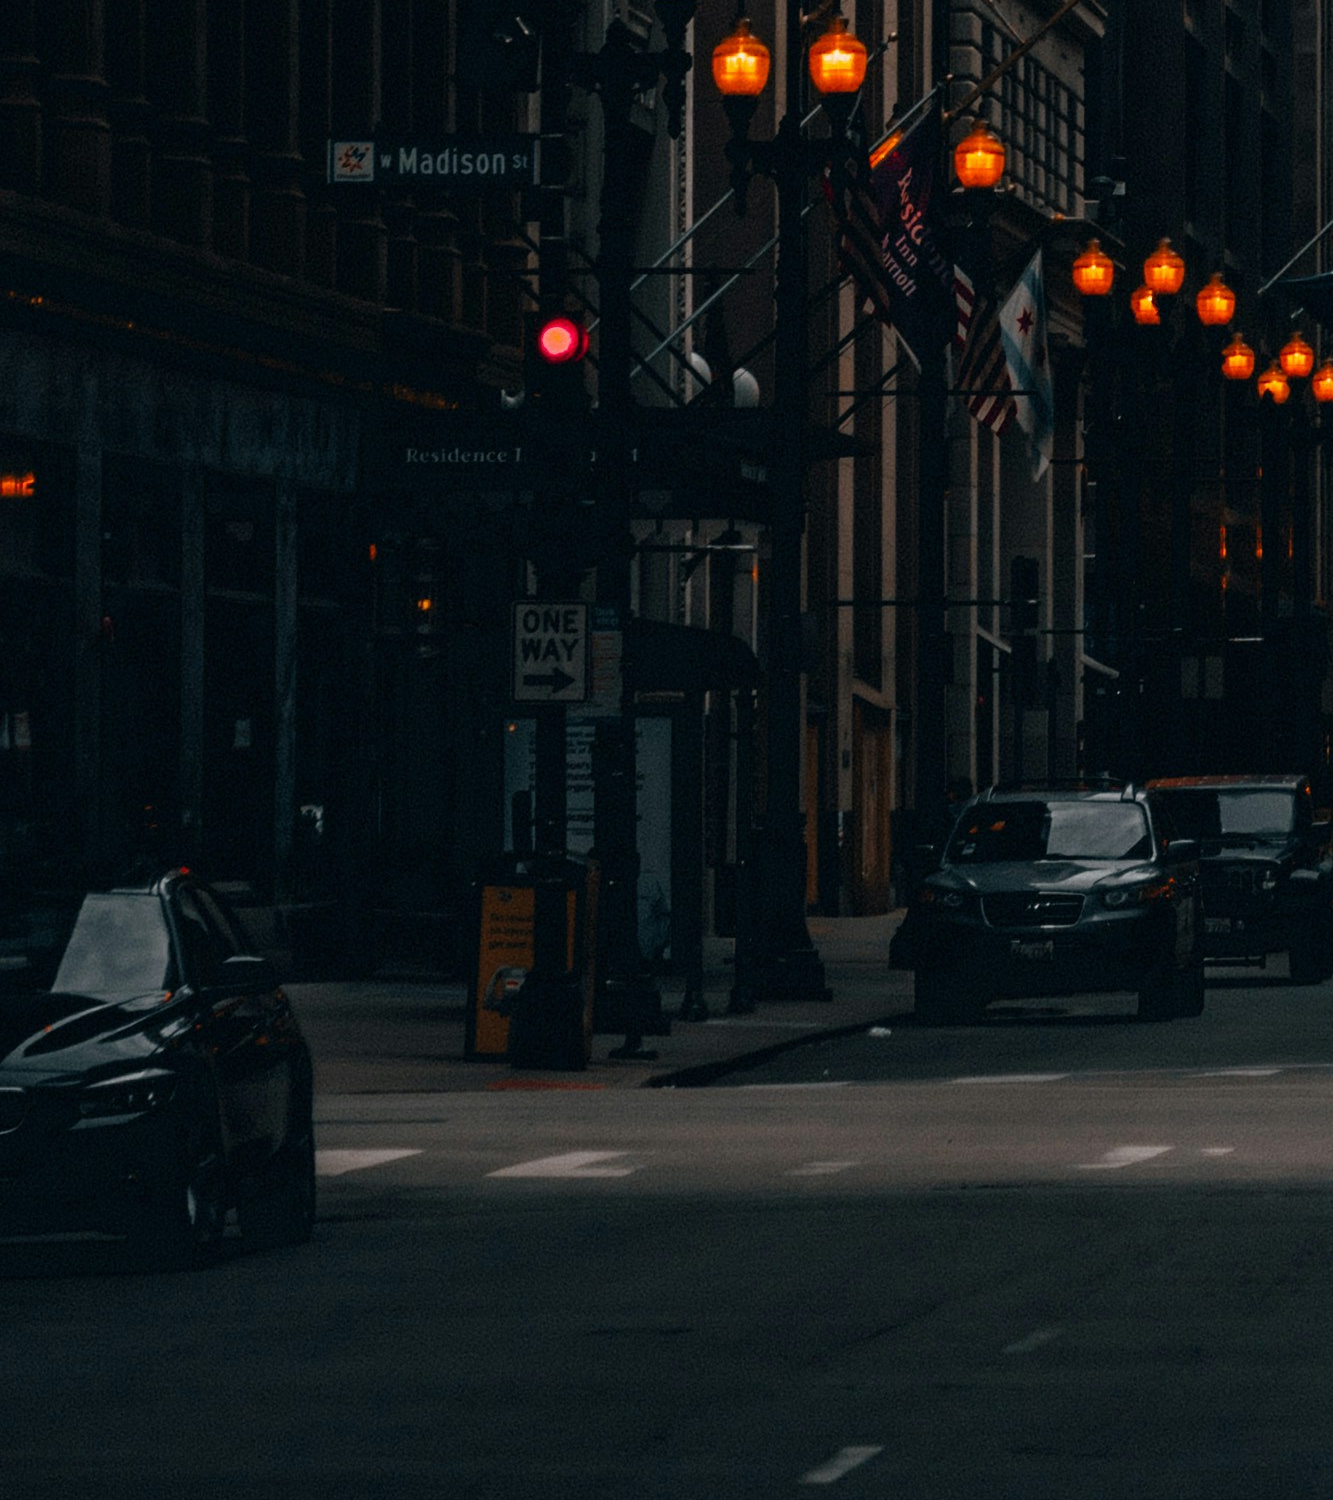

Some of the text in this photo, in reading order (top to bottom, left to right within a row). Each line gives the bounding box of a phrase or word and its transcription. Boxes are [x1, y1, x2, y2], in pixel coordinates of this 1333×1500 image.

[380, 147, 528, 176] W Madison St
[405, 447, 508, 464] Residence
[523, 609, 579, 634] ONE
[520, 638, 579, 662] WAY
